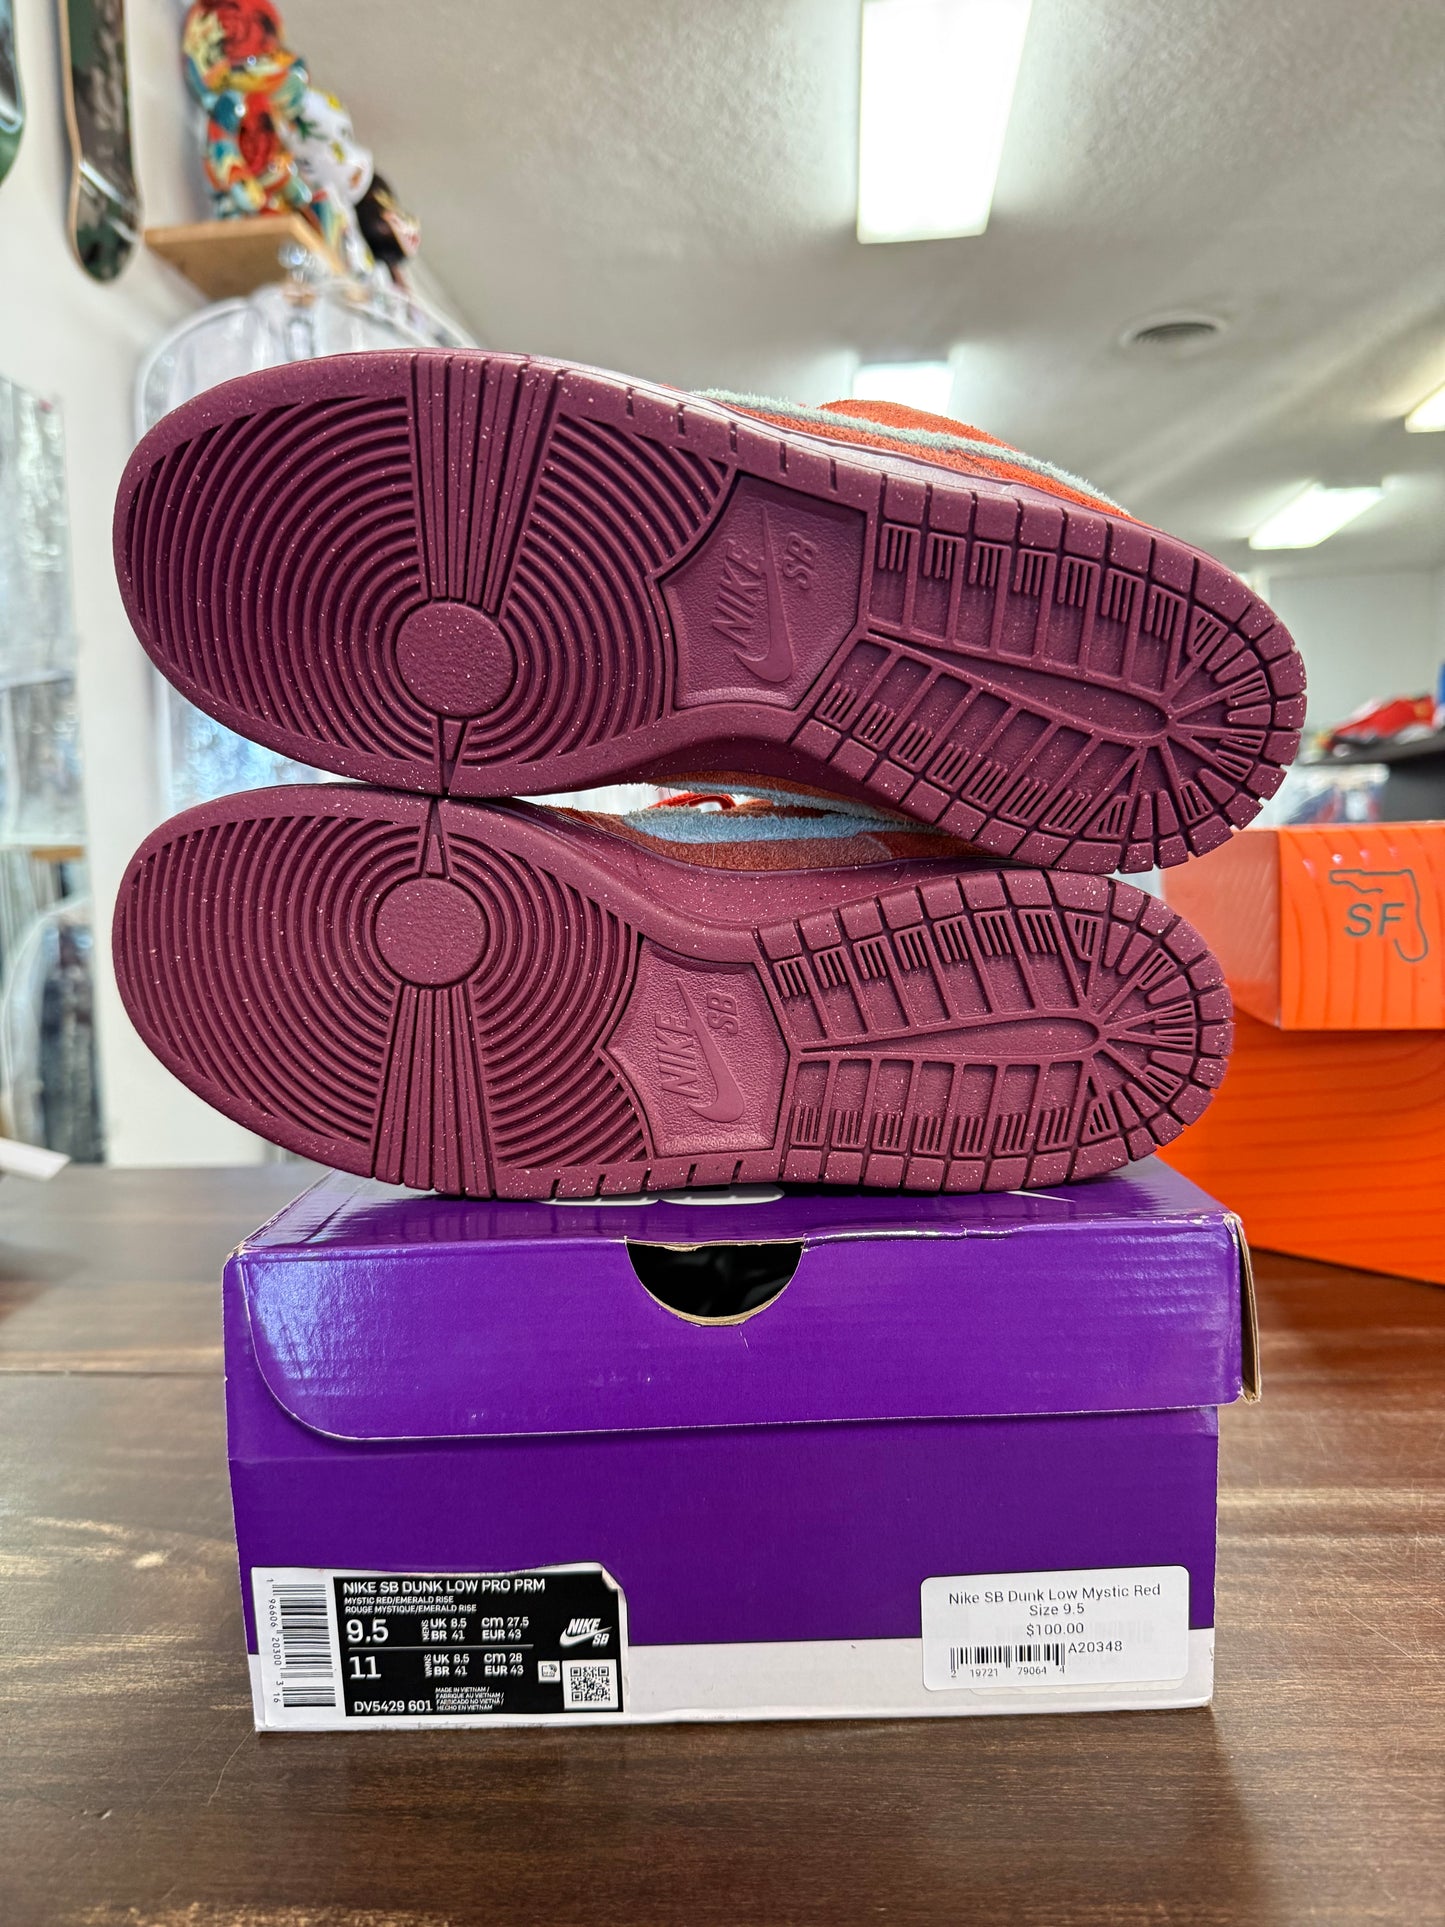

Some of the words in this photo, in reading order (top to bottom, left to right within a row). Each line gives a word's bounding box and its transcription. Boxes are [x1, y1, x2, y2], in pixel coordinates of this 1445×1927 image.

[782, 532, 818, 590] SB
[711, 539, 765, 648] NIKE
[1344, 902, 1405, 937] SF
[706, 990, 738, 1034] SB
[655, 1013, 700, 1100] NIKE
[343, 1582, 376, 1594] NIKE
[380, 1582, 400, 1594] SB
[402, 1580, 444, 1594] DUNK
[446, 1580, 478, 1593] LOW
[482, 1579, 510, 1592] PRO
[514, 1578, 546, 1592] PRM
[949, 1592, 980, 1604] Nike
[984, 1591, 1004, 1602] SB
[1008, 1589, 1044, 1602] Dunk
[1048, 1588, 1078, 1600] Low
[1082, 1585, 1129, 1600] Mystic
[1134, 1584, 1160, 1596] Red
[268, 1599, 278, 1628] 96606
[345, 1606, 374, 1614] ROUGE
[374, 1605, 458, 1614] MYSTIQUE/EMERALD
[459, 1604, 477, 1612] RISE
[1029, 1604, 1058, 1616] Size
[1063, 1602, 1085, 1615] 9.5
[430, 1618, 447, 1628] UK
[450, 1618, 467, 1628] 8.5
[482, 1618, 504, 1628] cm
[507, 1617, 529, 1628] 27.5
[566, 1618, 600, 1636] NIKE
[1026, 1622, 1084, 1637] $100.00
[346, 1619, 388, 1642] 9.5
[432, 1630, 447, 1640] BR
[452, 1630, 465, 1640] 41
[482, 1630, 506, 1640] EUR
[508, 1630, 522, 1640] 43
[592, 1633, 610, 1646] SB
[272, 1638, 282, 1666] 20300
[1068, 1640, 1122, 1654] A20348
[433, 1654, 450, 1664] UK
[454, 1654, 470, 1664] 8.5
[484, 1653, 506, 1664] cm
[509, 1653, 522, 1664] 28
[350, 1656, 382, 1680] 11
[434, 1667, 450, 1676] BR
[454, 1667, 468, 1676] 41
[485, 1666, 508, 1676] EUR
[510, 1666, 524, 1676] 43
[951, 1669, 957, 1678] 2
[970, 1668, 998, 1678] 19721
[1018, 1666, 1047, 1676] 79064
[1059, 1666, 1066, 1674] 4
[354, 1701, 405, 1713] DV5429
[408, 1700, 432, 1712] 601
